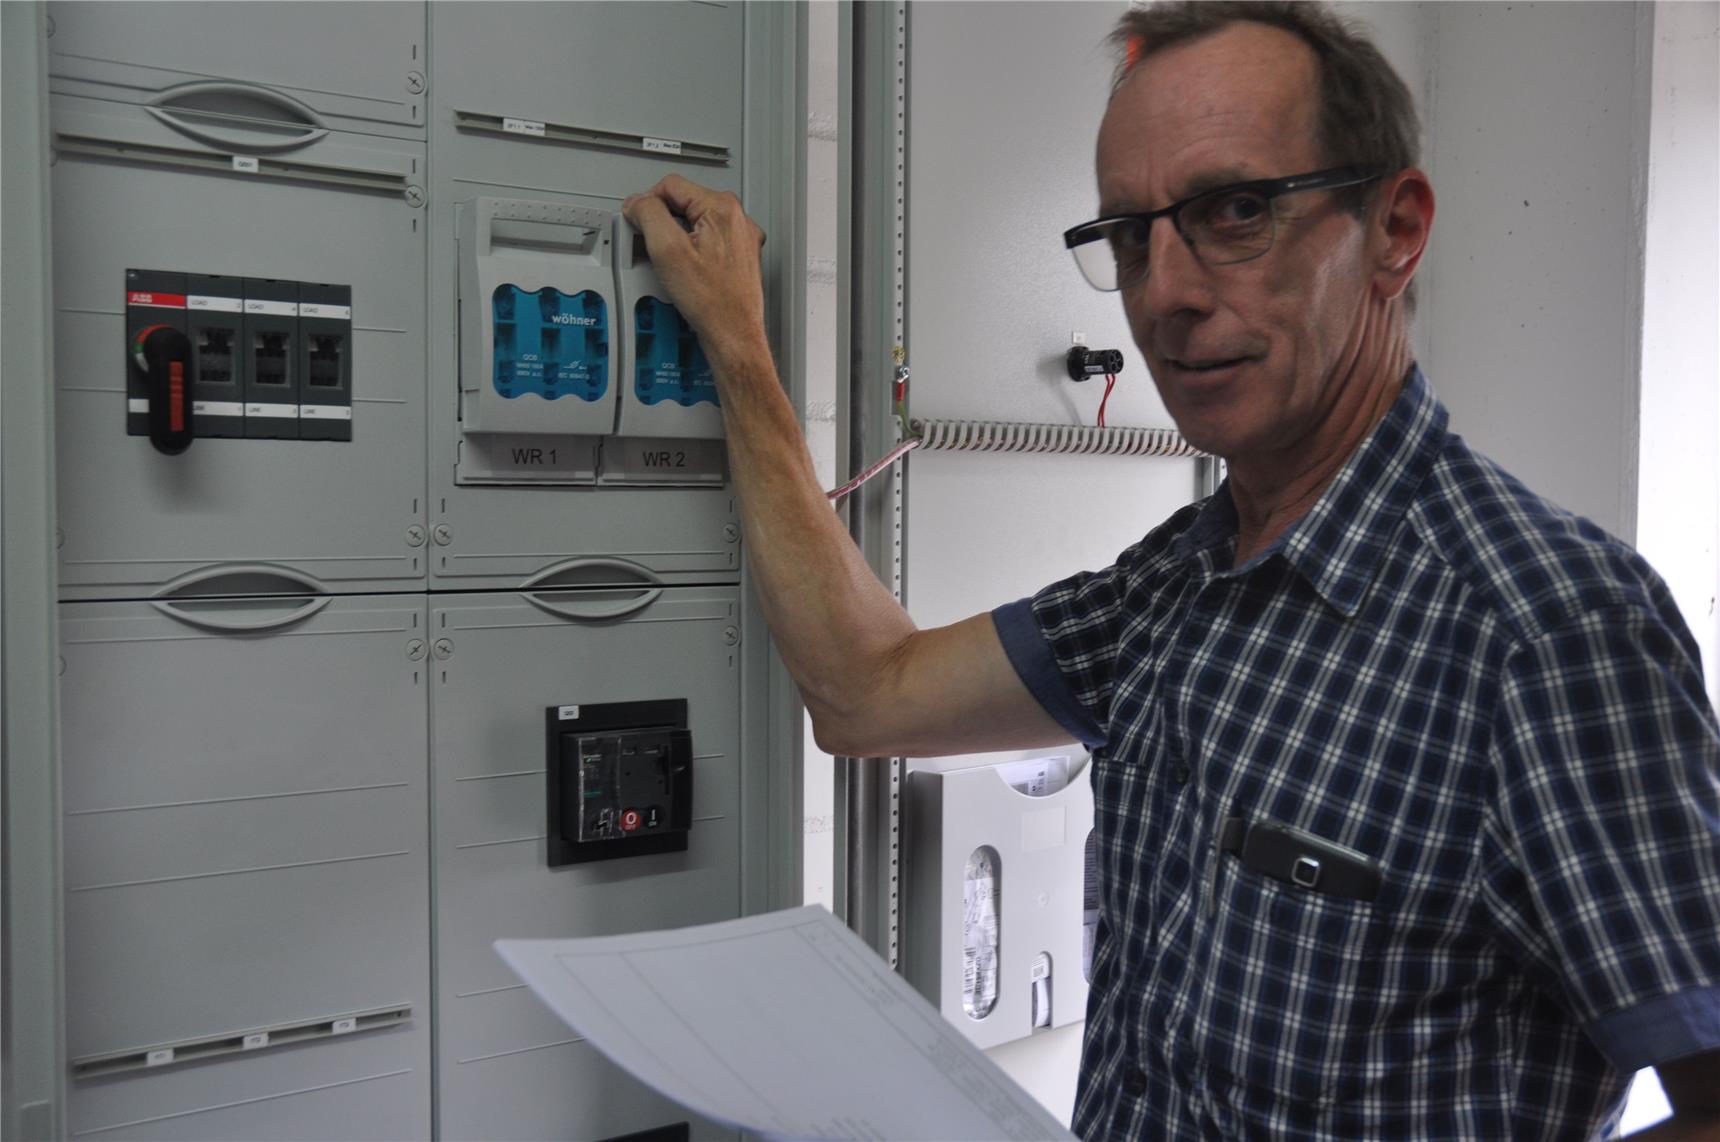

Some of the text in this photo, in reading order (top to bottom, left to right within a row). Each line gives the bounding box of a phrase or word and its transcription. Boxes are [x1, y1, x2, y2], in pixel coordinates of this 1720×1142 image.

[131, 293, 153, 304] ABB
[552, 313, 597, 326] wöhner
[511, 447, 556, 465] WR 1
[642, 451, 686, 467] WR 2
